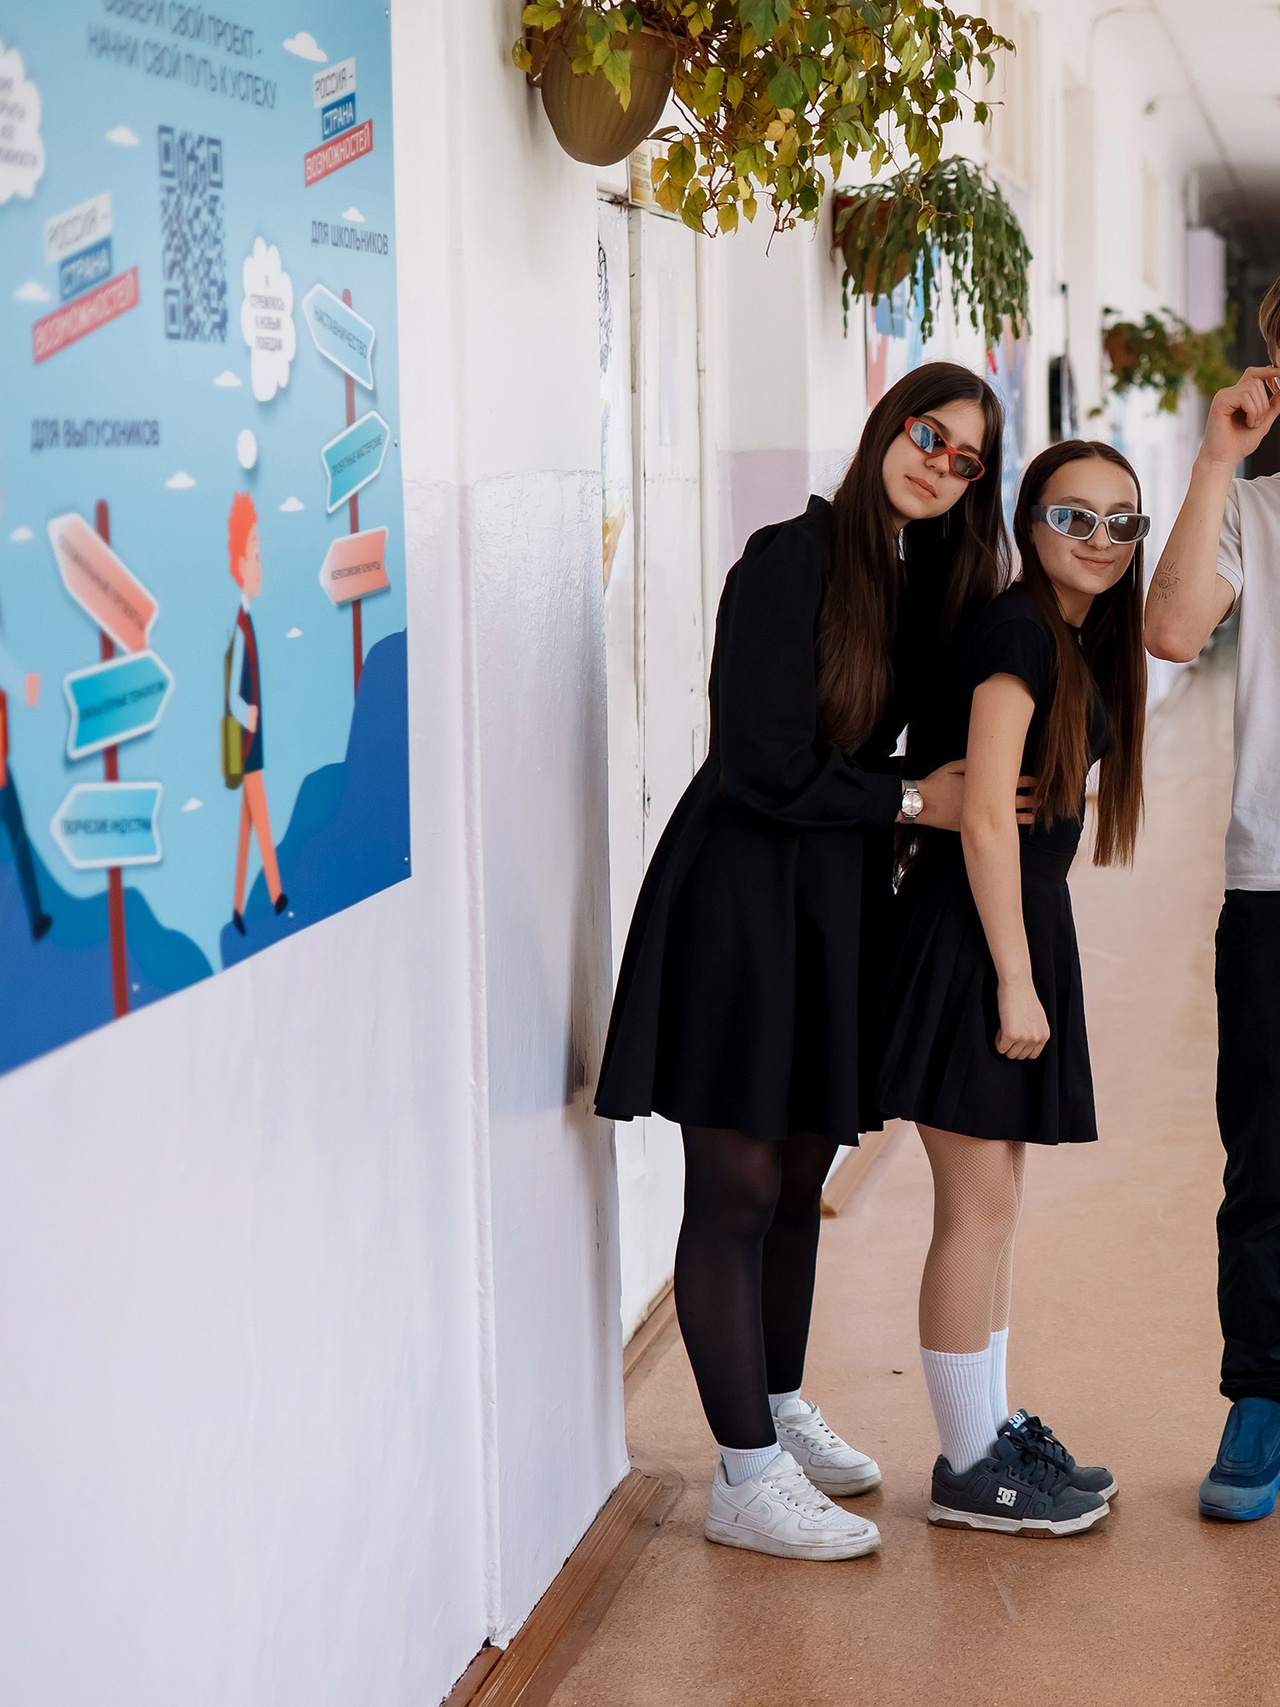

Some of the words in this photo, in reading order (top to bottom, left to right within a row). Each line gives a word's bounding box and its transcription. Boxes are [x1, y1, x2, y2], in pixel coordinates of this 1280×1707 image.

[208, 15, 253, 57] ПРОЕКТ
[142, 40, 181, 79] СВОЙ
[184, 53, 217, 92] ПУТЬ
[228, 66, 277, 110] УСПЕХУ
[314, 67, 347, 101] РОССИЯ
[323, 100, 355, 136] СТРАНА
[305, 123, 371, 181] ВОЗМОЖНОСТЕЙ
[311, 220, 328, 247] ДЛЯ
[331, 223, 389, 256] ШКОЛЬНИКОВ
[313, 304, 368, 360] НАСТАВНИЧЕСТВО
[31, 419, 58, 452] ДЛЯ
[63, 418, 160, 447] ВЫПУСКНИКОВ
